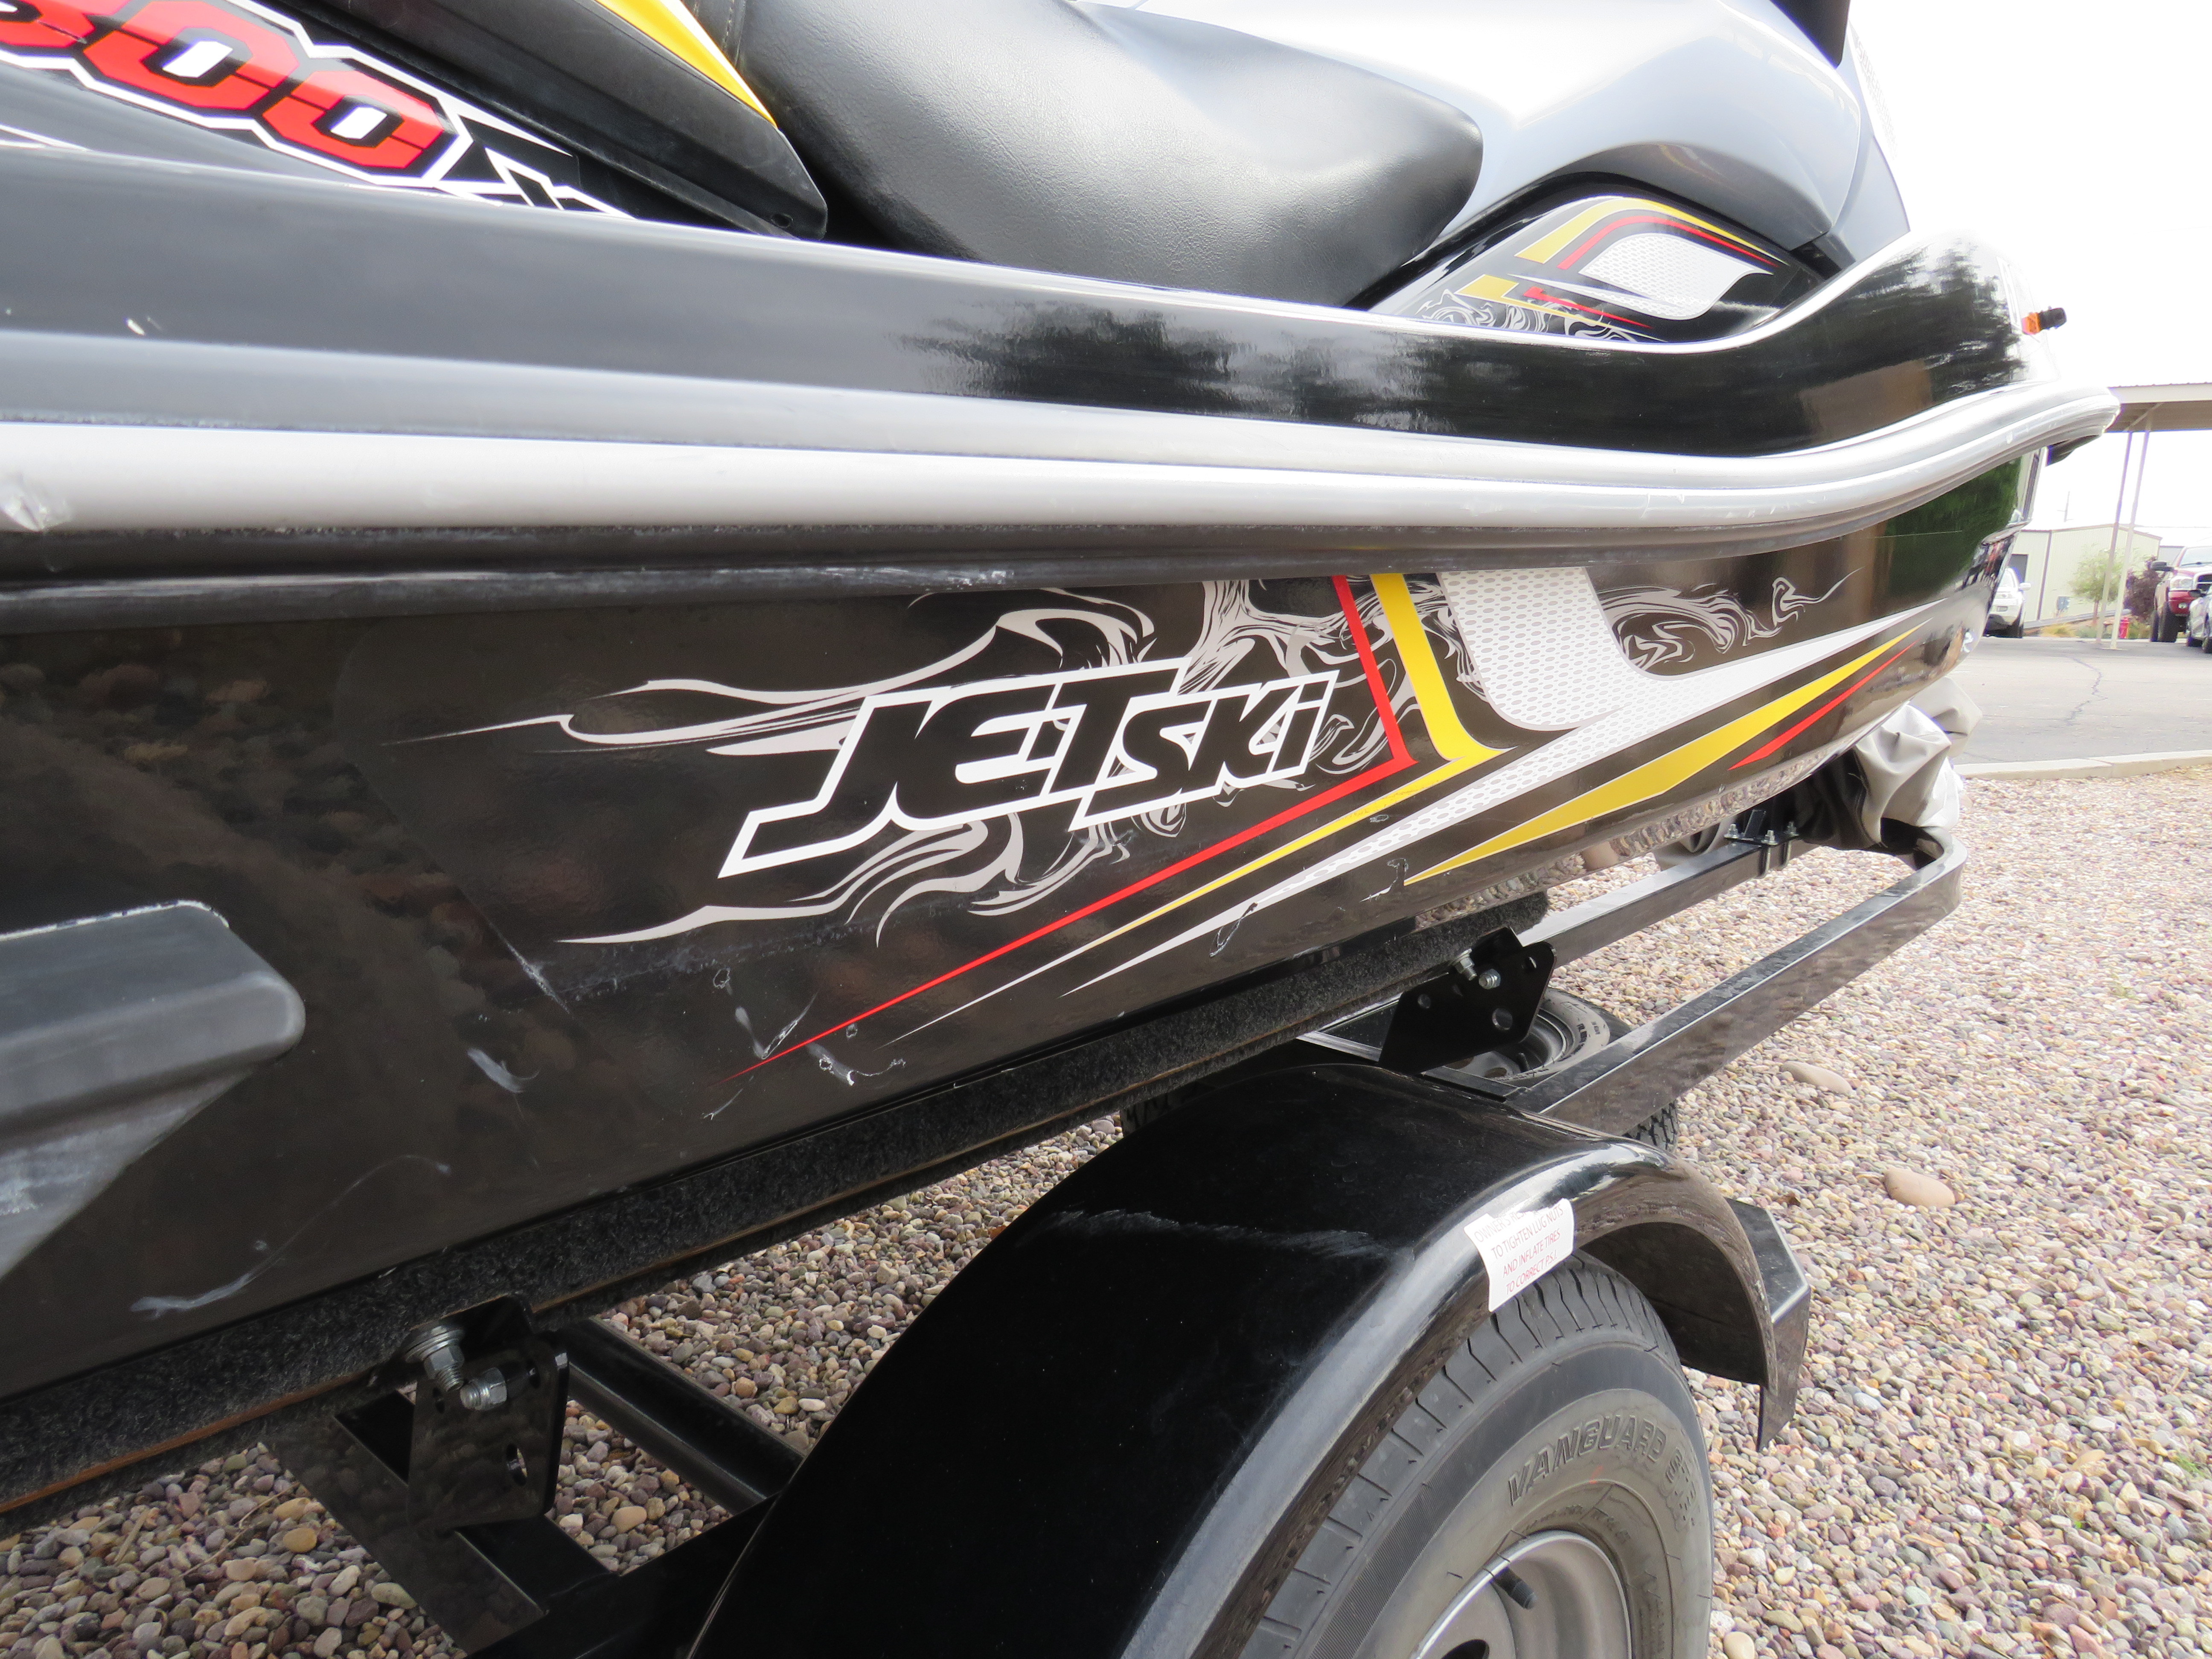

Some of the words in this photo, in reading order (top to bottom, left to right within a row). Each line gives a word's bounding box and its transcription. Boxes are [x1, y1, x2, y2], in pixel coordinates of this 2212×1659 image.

[1474, 1216, 1511, 1242] OWNER'S
[1491, 1245, 1503, 1259] TO
[1502, 1225, 1533, 1253] TIGHTEN
[1532, 1216, 1547, 1234] LUG
[1546, 1204, 1563, 1224] NUTS
[1503, 1259, 1518, 1278] AND
[1519, 1240, 1543, 1266] INFLATE
[1544, 1228, 1560, 1248] TIRES
[1506, 1281, 1515, 1295] TO
[1516, 1258, 1545, 1287] CORRECT
[1508, 1414, 1667, 1506] VANGUARD
